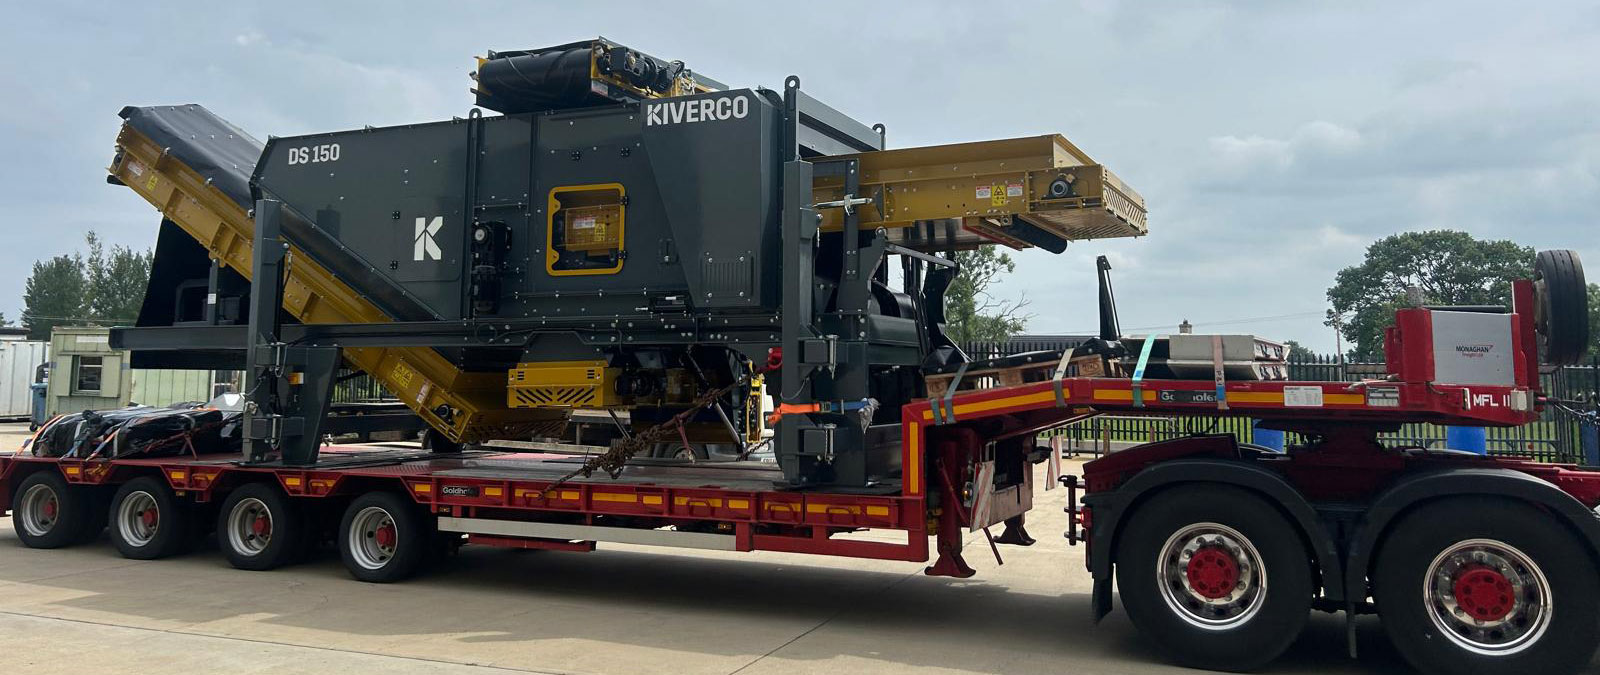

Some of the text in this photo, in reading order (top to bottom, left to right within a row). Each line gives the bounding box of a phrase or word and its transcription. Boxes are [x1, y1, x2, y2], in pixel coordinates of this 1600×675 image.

[647, 96, 748, 126] KIVERCO
[288, 143, 340, 165] DS 150
[414, 216, 443, 261] K
[1456, 345, 1489, 353] MONAGHAN
[1473, 394, 1499, 407] MFL
